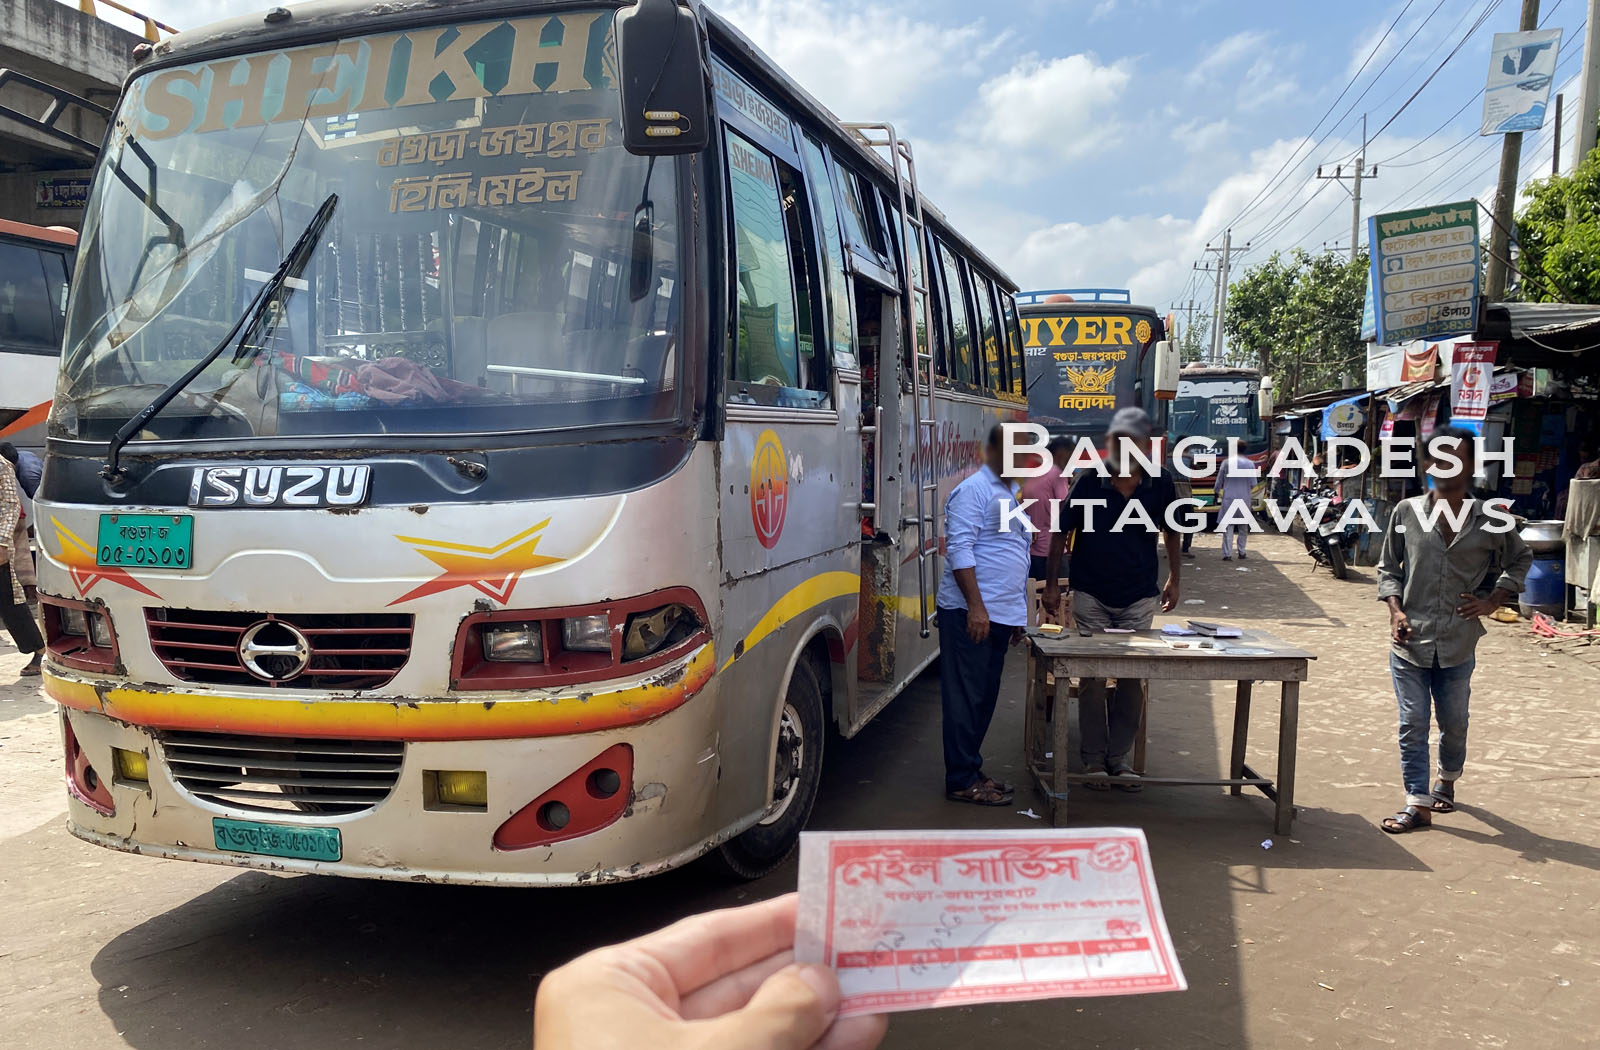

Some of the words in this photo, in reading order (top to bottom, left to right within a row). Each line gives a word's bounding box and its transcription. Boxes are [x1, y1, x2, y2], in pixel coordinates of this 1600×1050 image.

[136, 12, 604, 141] SHEIKH
[1441, 306, 1471, 317] উপায়
[1020, 315, 1133, 347] IYER
[1059, 394, 1116, 411] নিরাপদ
[189, 465, 371, 507] ISUZU
[842, 848, 944, 887] মেইল
[952, 846, 1082, 884] সার্ভিস
